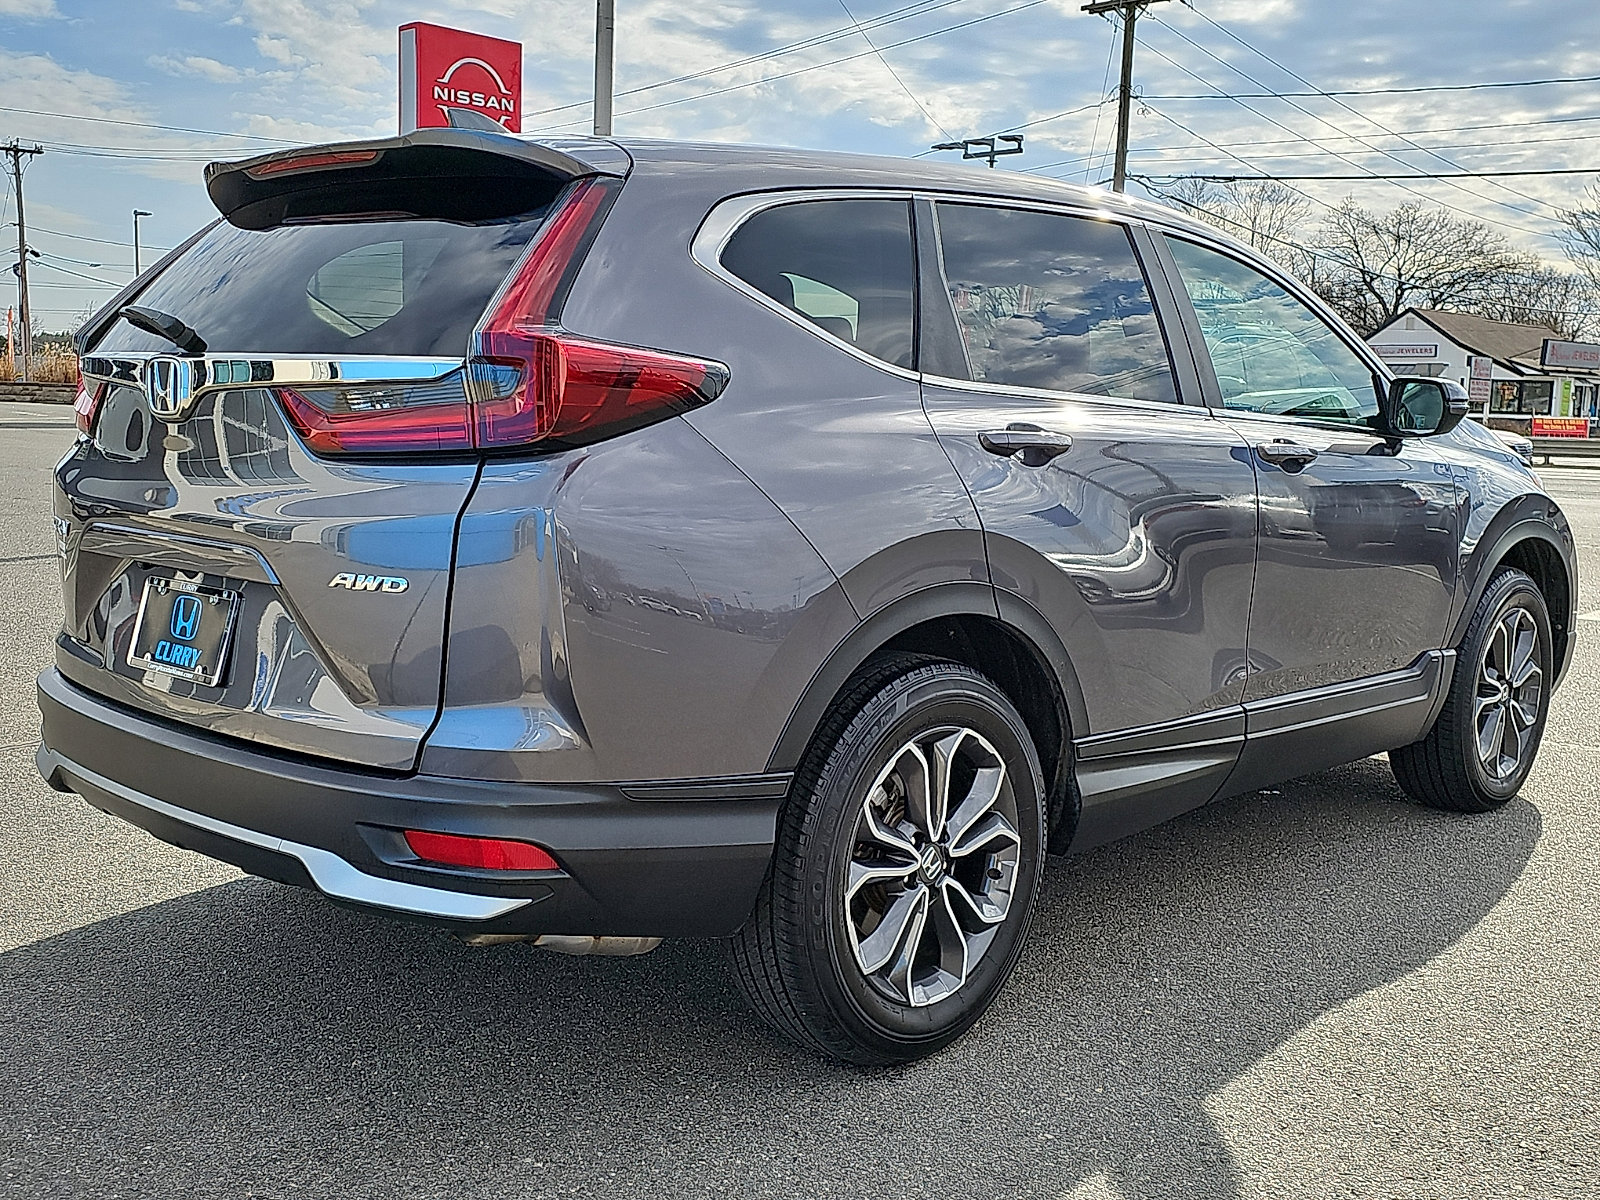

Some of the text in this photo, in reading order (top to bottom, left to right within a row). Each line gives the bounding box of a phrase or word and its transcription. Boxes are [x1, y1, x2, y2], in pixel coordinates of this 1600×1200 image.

[433, 86, 514, 112] NISSAN
[180, 583, 199, 592] CURRY
[328, 571, 409, 593] AWD
[155, 640, 203, 669] CURRY
